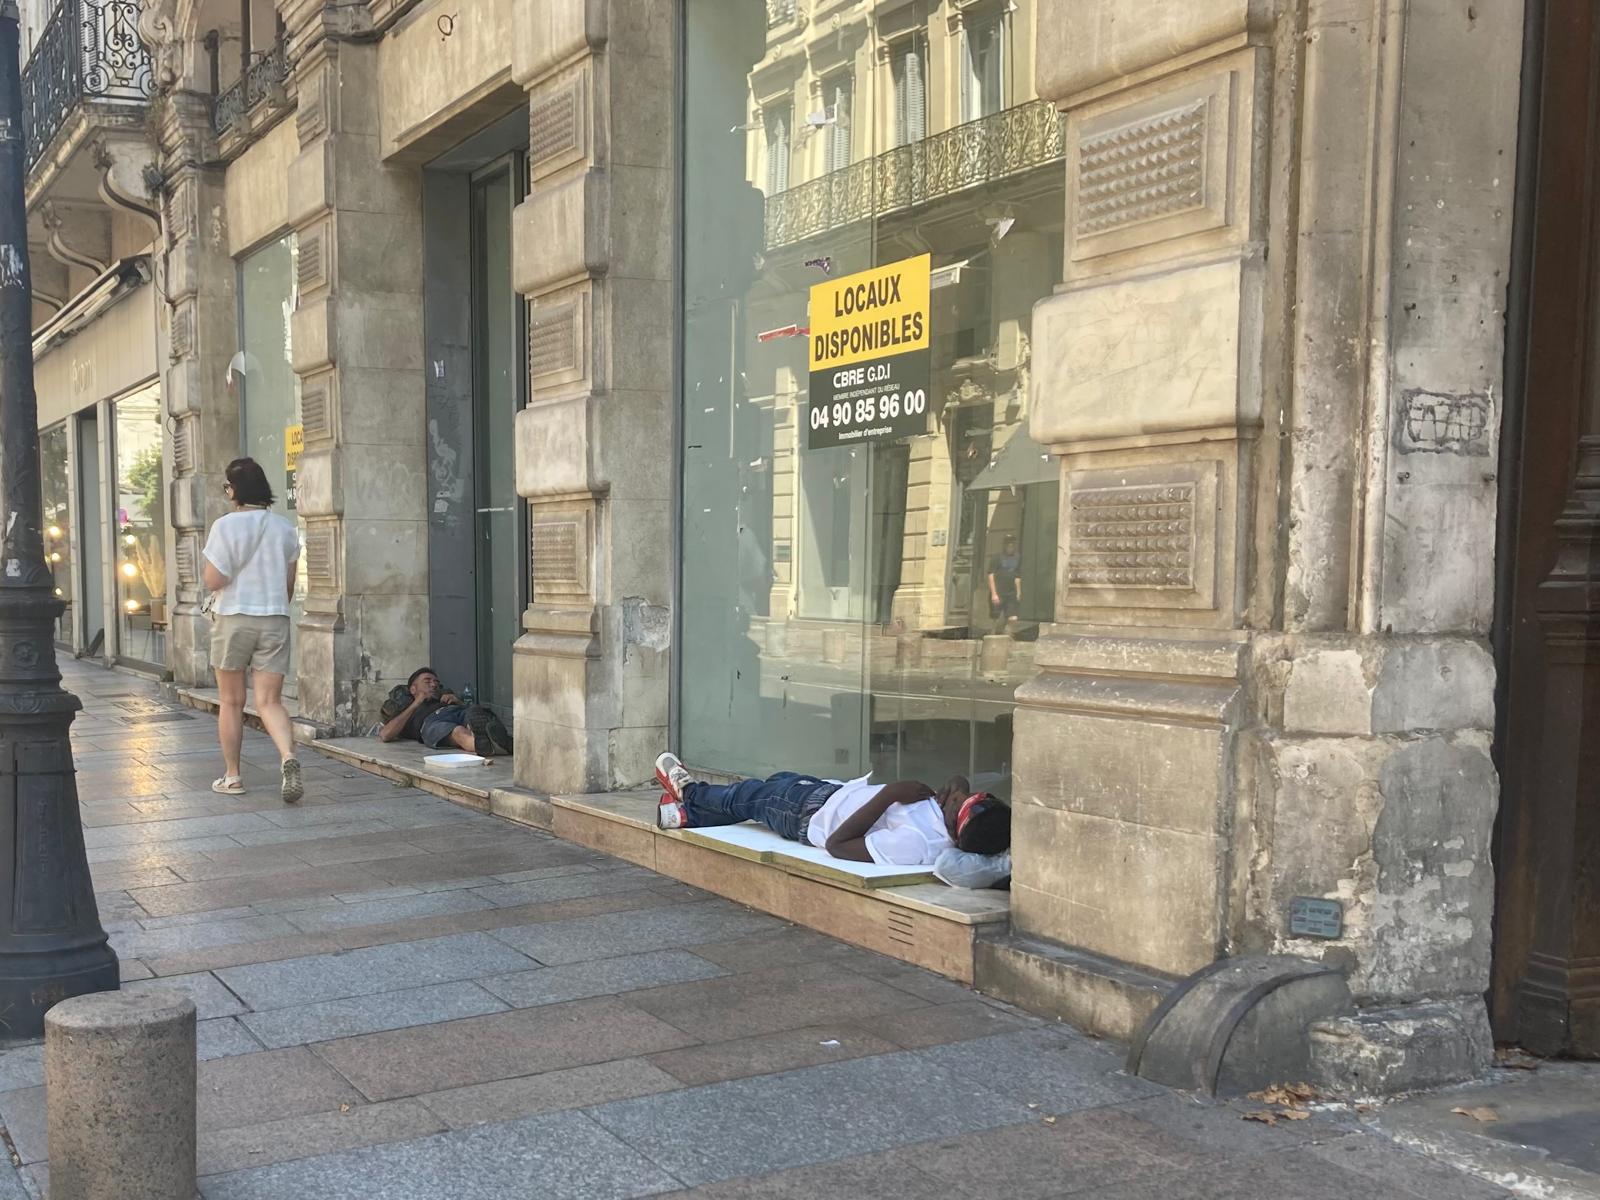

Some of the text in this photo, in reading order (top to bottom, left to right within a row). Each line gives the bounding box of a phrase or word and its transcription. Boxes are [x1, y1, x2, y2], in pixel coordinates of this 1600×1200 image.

[835, 274, 901, 317] LOCAUX
[815, 311, 923, 361] DISPONIBLES
[833, 363, 891, 389] CBRE G.D.I
[811, 389, 926, 430] 04 90 85 96 00
[839, 426, 893, 440] Immobilier d'entreprise
